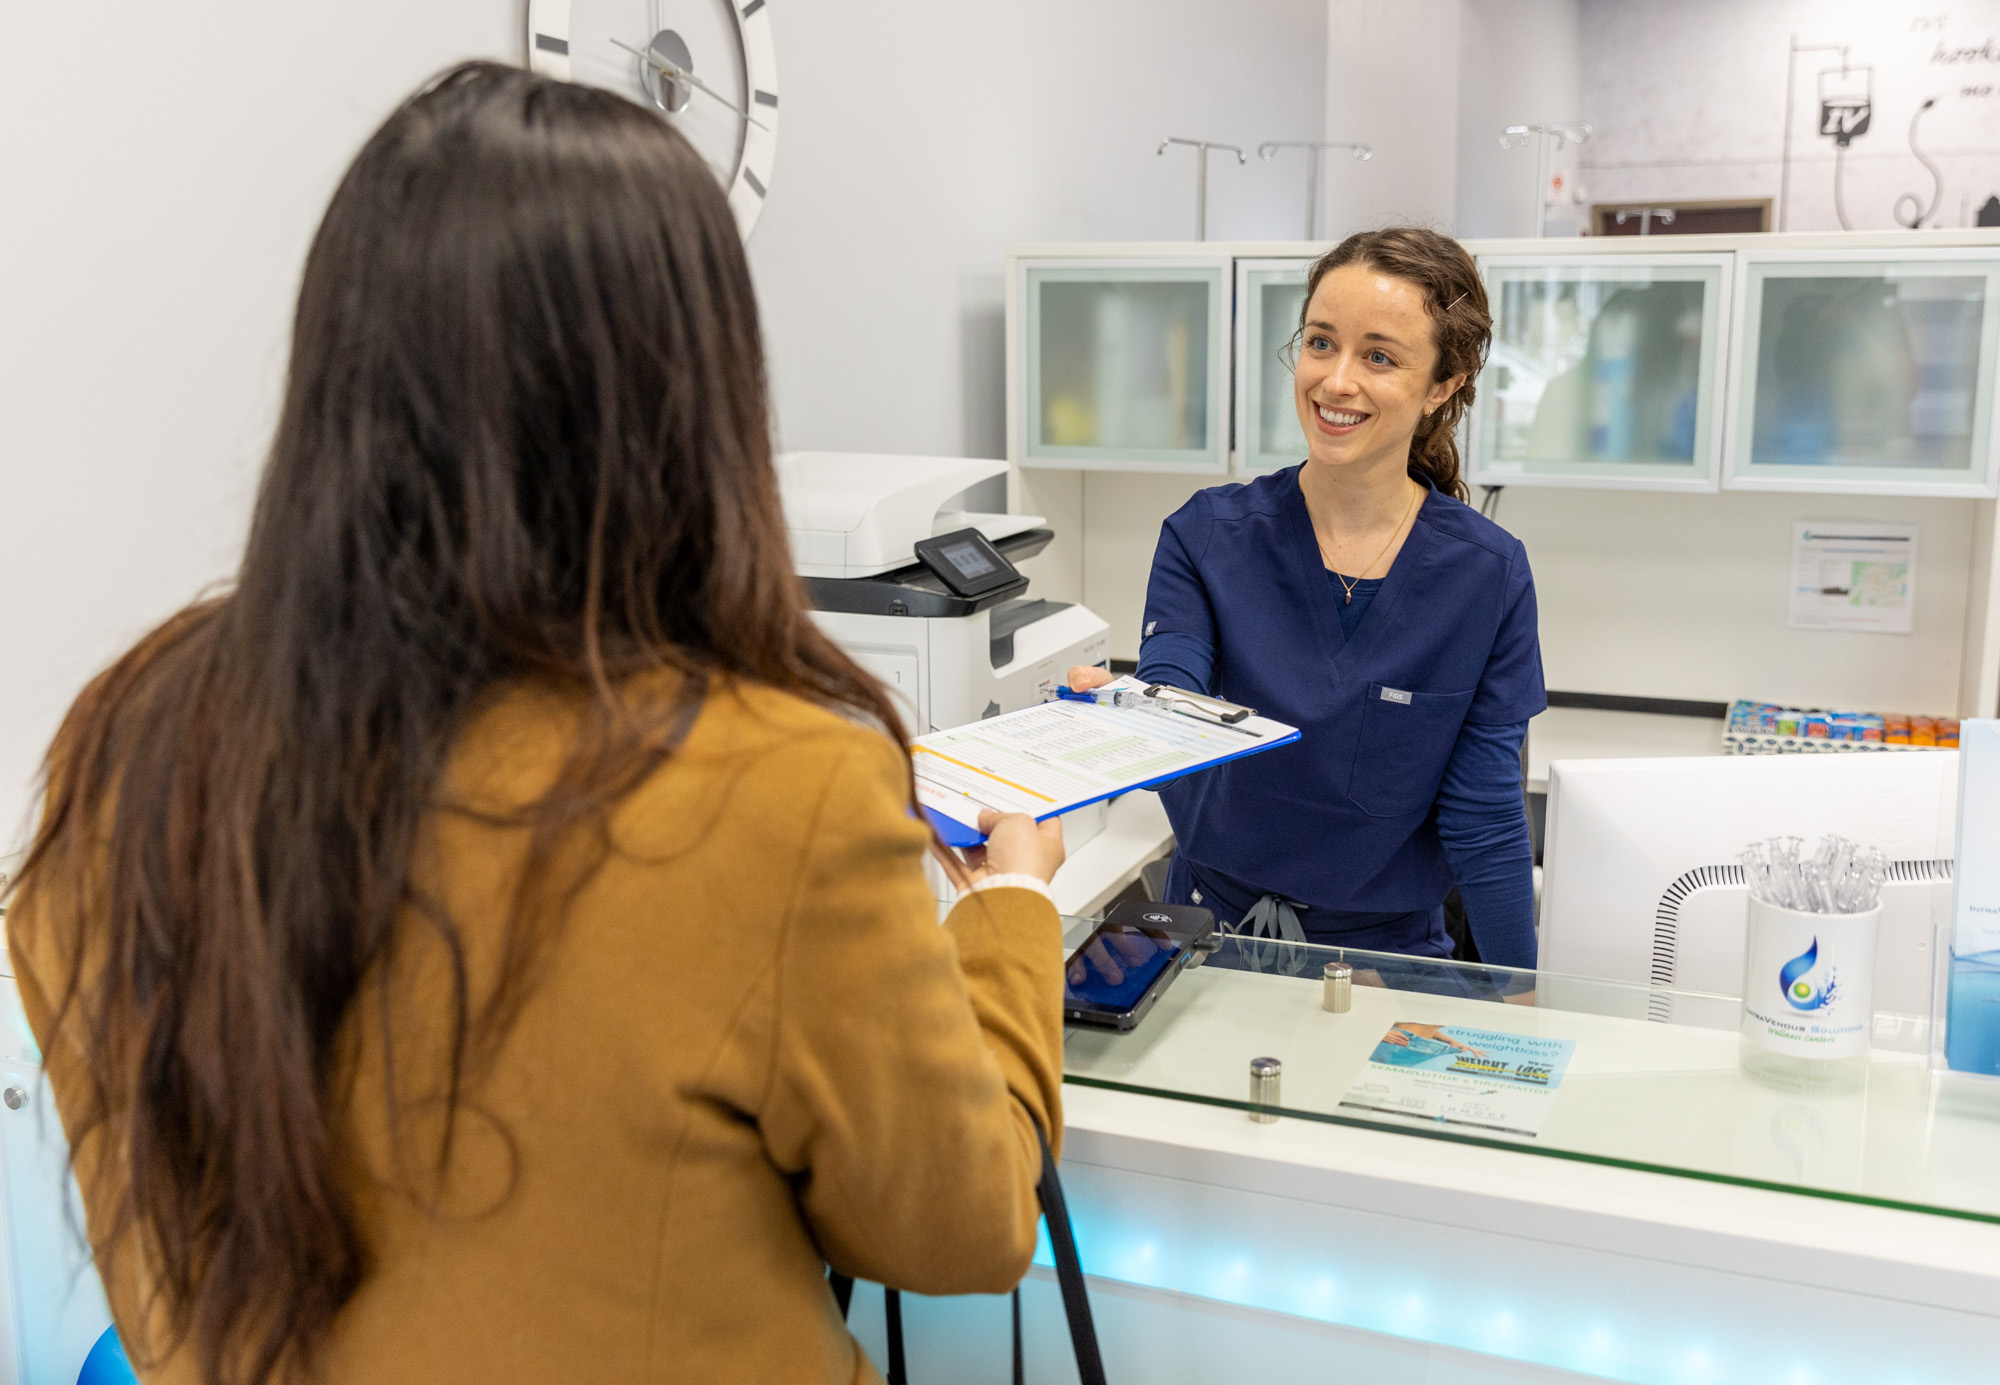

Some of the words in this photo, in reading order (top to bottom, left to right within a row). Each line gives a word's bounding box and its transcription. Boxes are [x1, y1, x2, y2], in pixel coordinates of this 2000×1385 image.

[1822, 107, 1869, 134] IV
[895, 671, 901, 684] 1
[1388, 691, 1404, 701] FIGS
[1447, 1028, 1521, 1046] struggling
[1527, 1038, 1564, 1050] with
[1468, 1040, 1560, 1058] weightloss?
[1370, 1064, 1457, 1082] SEMAGLUTIDE
